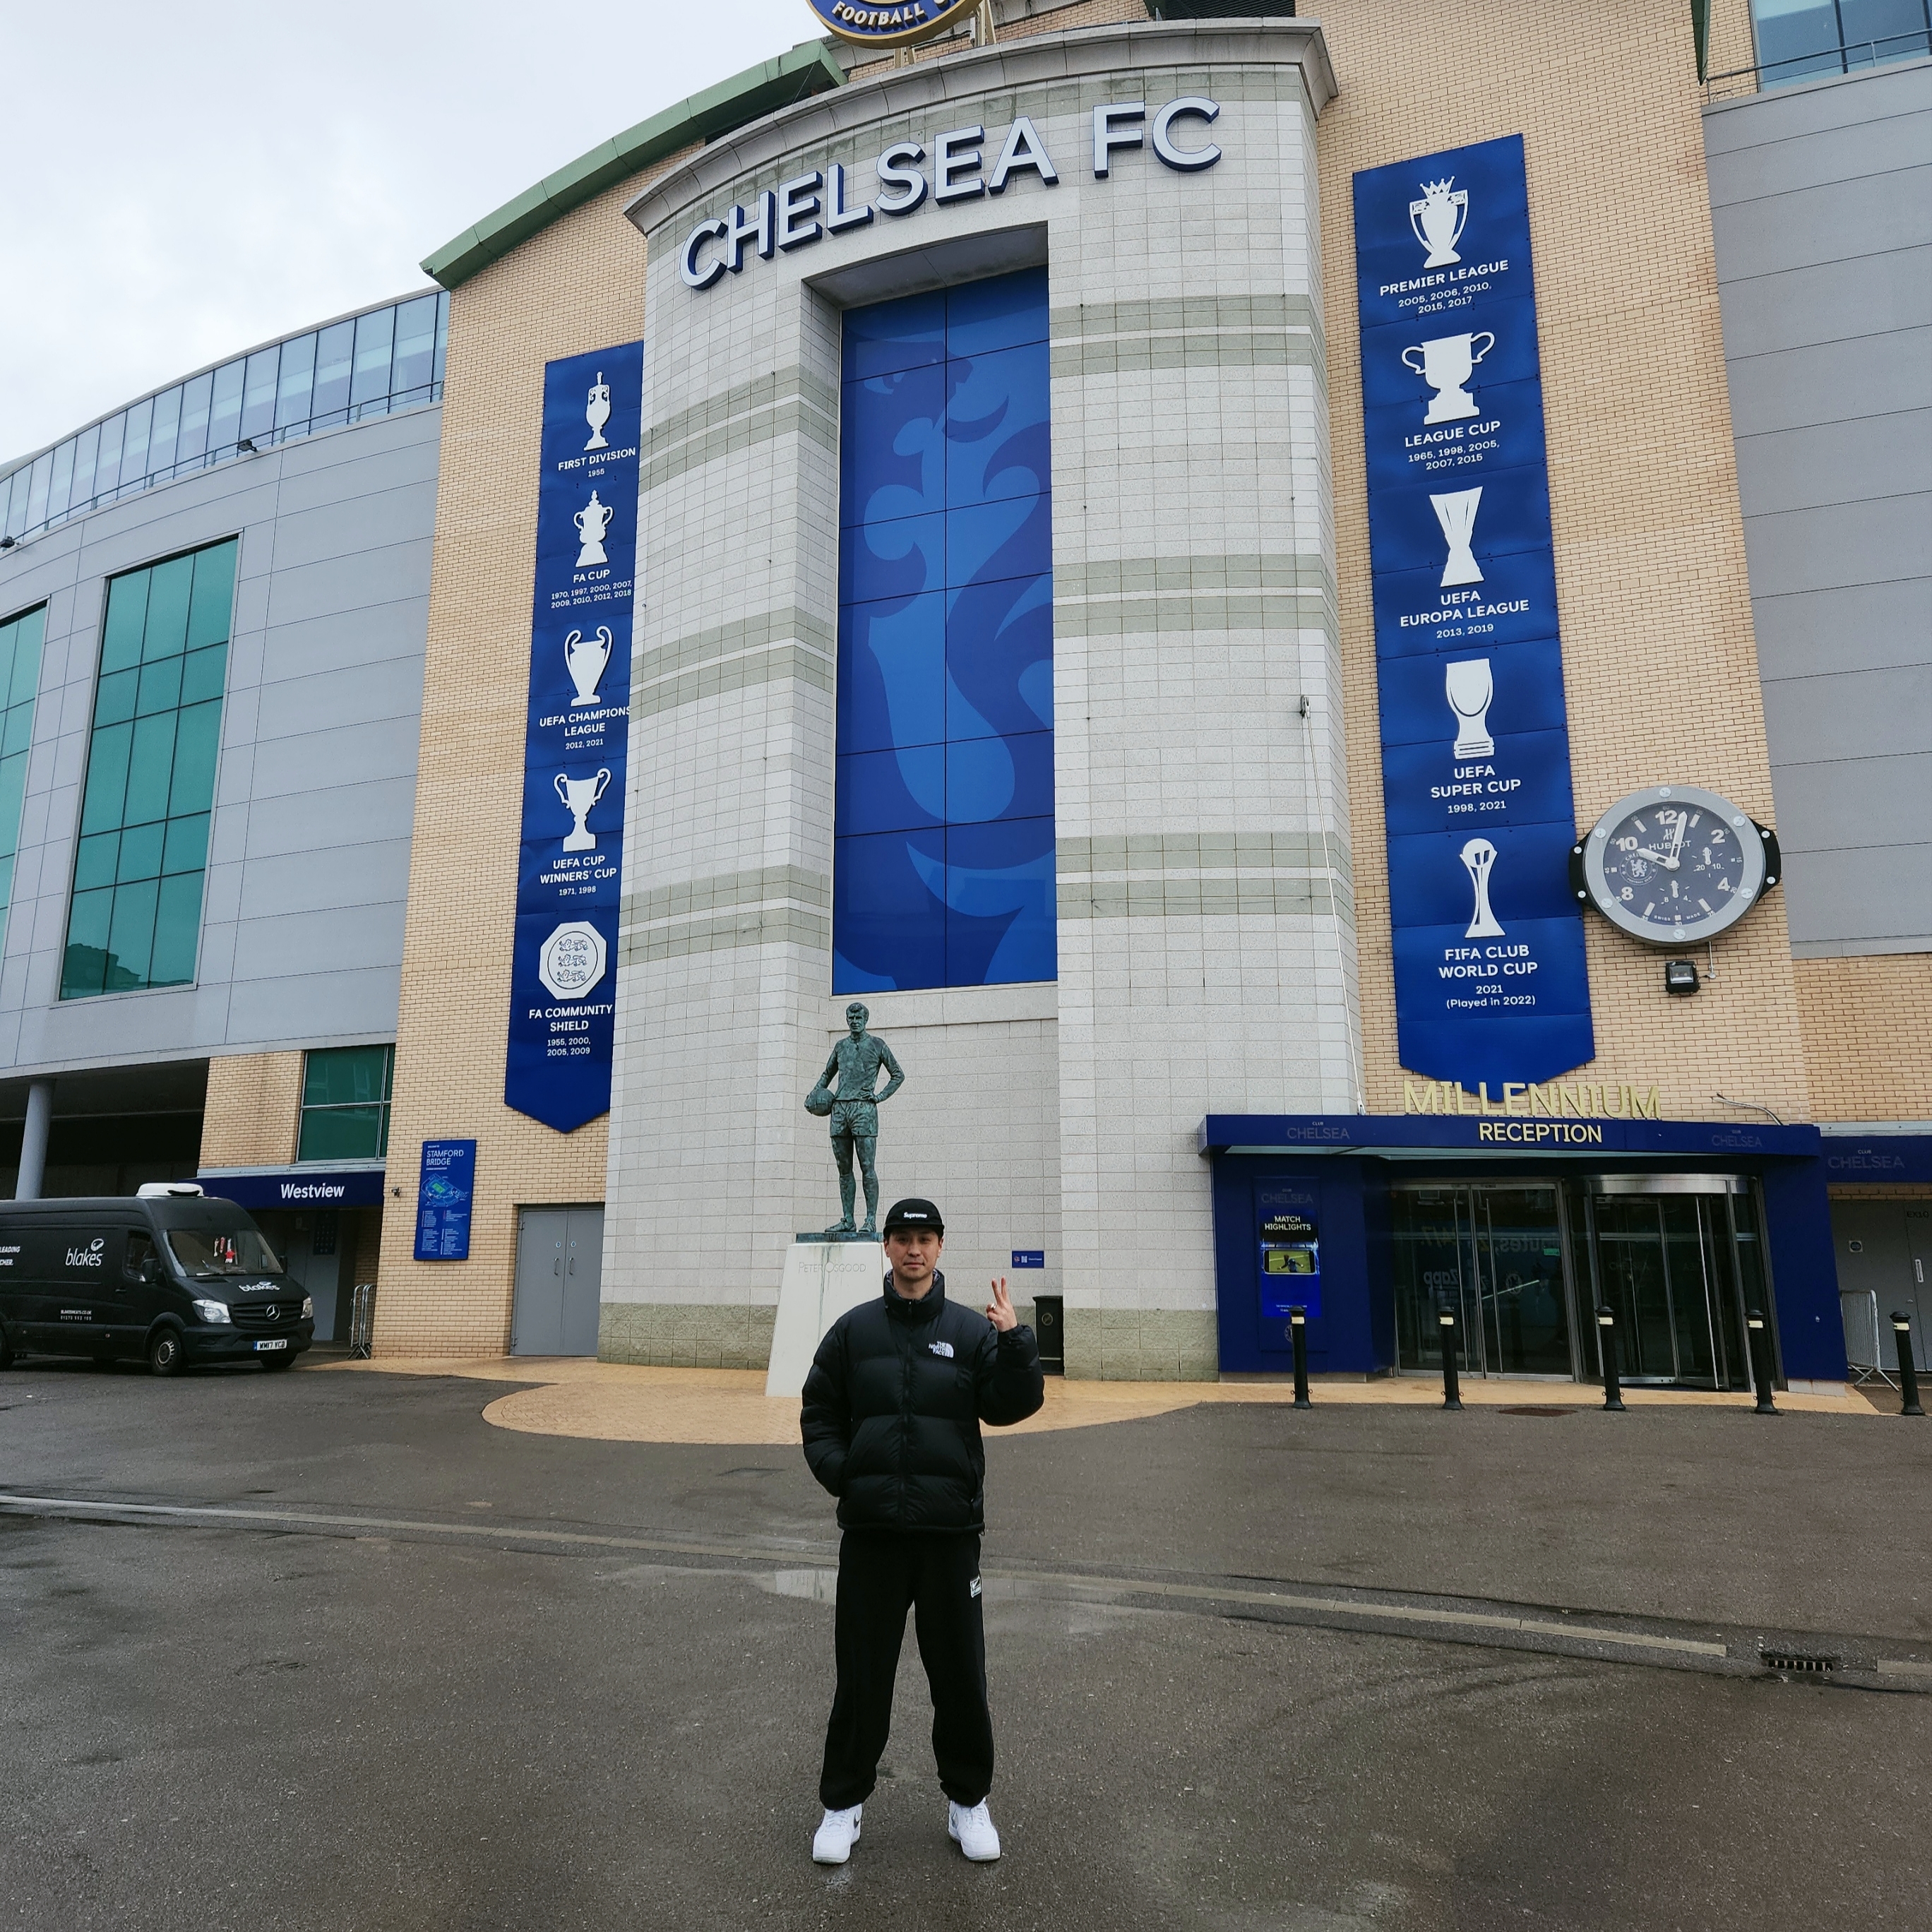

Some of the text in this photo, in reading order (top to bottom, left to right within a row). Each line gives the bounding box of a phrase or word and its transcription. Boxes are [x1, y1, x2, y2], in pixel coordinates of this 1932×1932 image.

[831, 1, 925, 27] FOOTBALL
[678, 96, 1222, 290] CHELSEA FC
[1379, 259, 1509, 297] PREMIER LEAGUE
[1398, 282, 1492, 308] 2005, 2006, 2010,
[1418, 296, 1473, 314] 2015, 2017
[1405, 421, 1501, 448] LEAGUE CUP
[558, 447, 636, 471] FIRST DIVISION
[1408, 440, 1500, 463] 1965, 1998, 2005,
[1426, 453, 1483, 471] 2007, 2015
[588, 468, 605, 477] 1955
[573, 569, 610, 583] FA CUP
[551, 580, 632, 600] 1970, 1997, 2000, 2007,
[551, 589, 632, 609] 2009, 2010, 2012, 2018
[1441, 590, 1481, 606] UEFA
[1400, 600, 1530, 627] EUROPA LEAGUE
[1436, 624, 1494, 639] 2013, 2019
[539, 715, 566, 727] UEFA
[564, 723, 606, 737] LEAGUE
[565, 738, 604, 750] 2012, 2021
[1454, 765, 1495, 780] UEFA
[1431, 779, 1521, 799] SUPER CUP
[1448, 800, 1507, 813] 1998, 2021
[1655, 810, 1678, 825] 12
[1616, 836, 1638, 852] 10
[1711, 829, 1725, 844] 2
[1649, 840, 1691, 850] HUBOT
[552, 855, 605, 869] UEFA CUP
[540, 868, 616, 884] WINNERS' CUP
[559, 886, 596, 896] 1971, 1998
[1717, 877, 1730, 891] 4
[1621, 886, 1634, 900] 8
[1445, 945, 1530, 961] FIFA CLUB
[1438, 962, 1538, 979] WORLD CUP
[1475, 985, 1503, 994] 2021
[1446, 995, 1536, 1010] (Played in 2022)
[529, 1004, 613, 1019] FA COMMUNITY
[549, 1020, 589, 1032] SHIELD
[547, 1037, 591, 1046] 1955, 2000,
[547, 1046, 590, 1056] 2005, 2009
[1403, 1080, 1662, 1120] MILLENNIUM
[1287, 1127, 1350, 1139] CHELSEA
[1479, 1122, 1603, 1143] RECEPTION
[1712, 1135, 1763, 1147] CHELSEA
[427, 1150, 464, 1158] STAMFORD
[1827, 1155, 1905, 1169] CHELSEA
[281, 1183, 345, 1199] Westview
[1261, 1193, 1313, 1204] CHELSEA
[1264, 1223, 1311, 1232] HIGHLIGHTS
[65, 1248, 103, 1266] blakes
